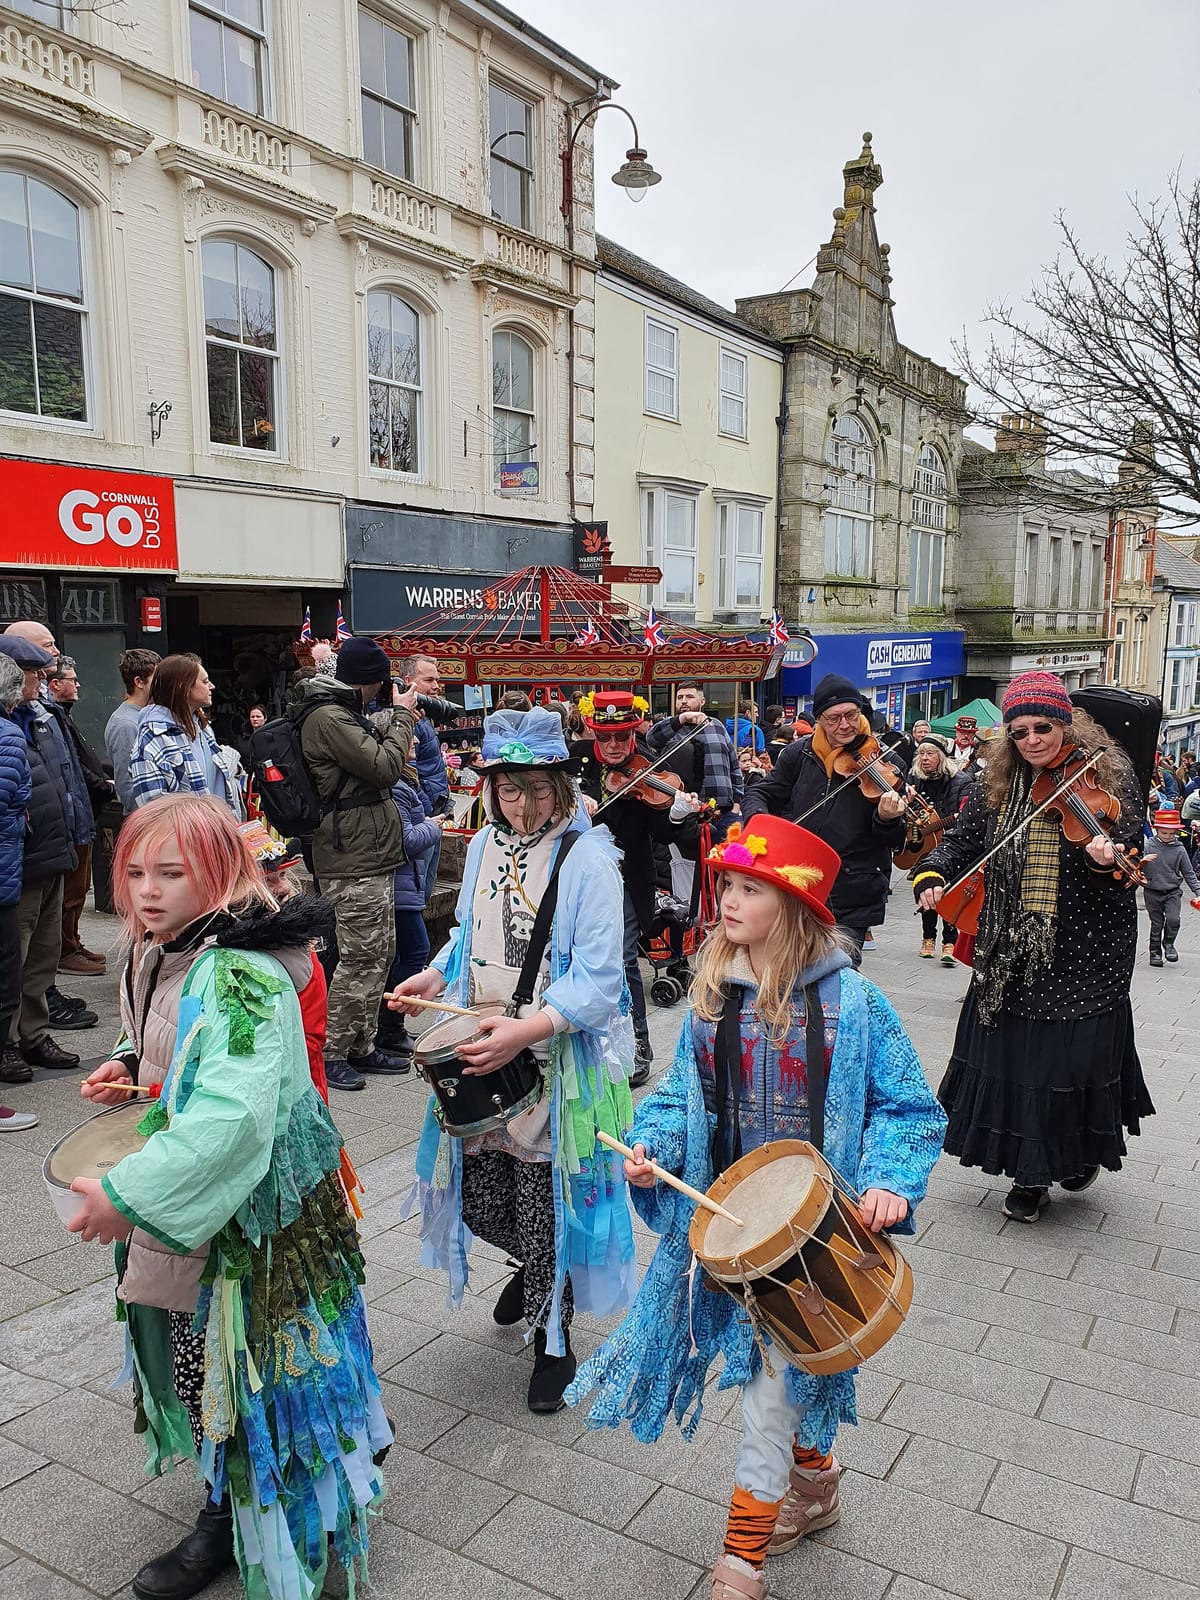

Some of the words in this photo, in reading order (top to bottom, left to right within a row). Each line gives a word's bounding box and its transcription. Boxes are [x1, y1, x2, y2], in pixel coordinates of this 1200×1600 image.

[101, 491, 159, 506] CORNWALL
[142, 507, 161, 549] bus
[405, 586, 484, 609] WARRENS
[498, 590, 542, 611] BAKER
[870, 645, 890, 665] CASH
[892, 643, 932, 662] GENERATOR
